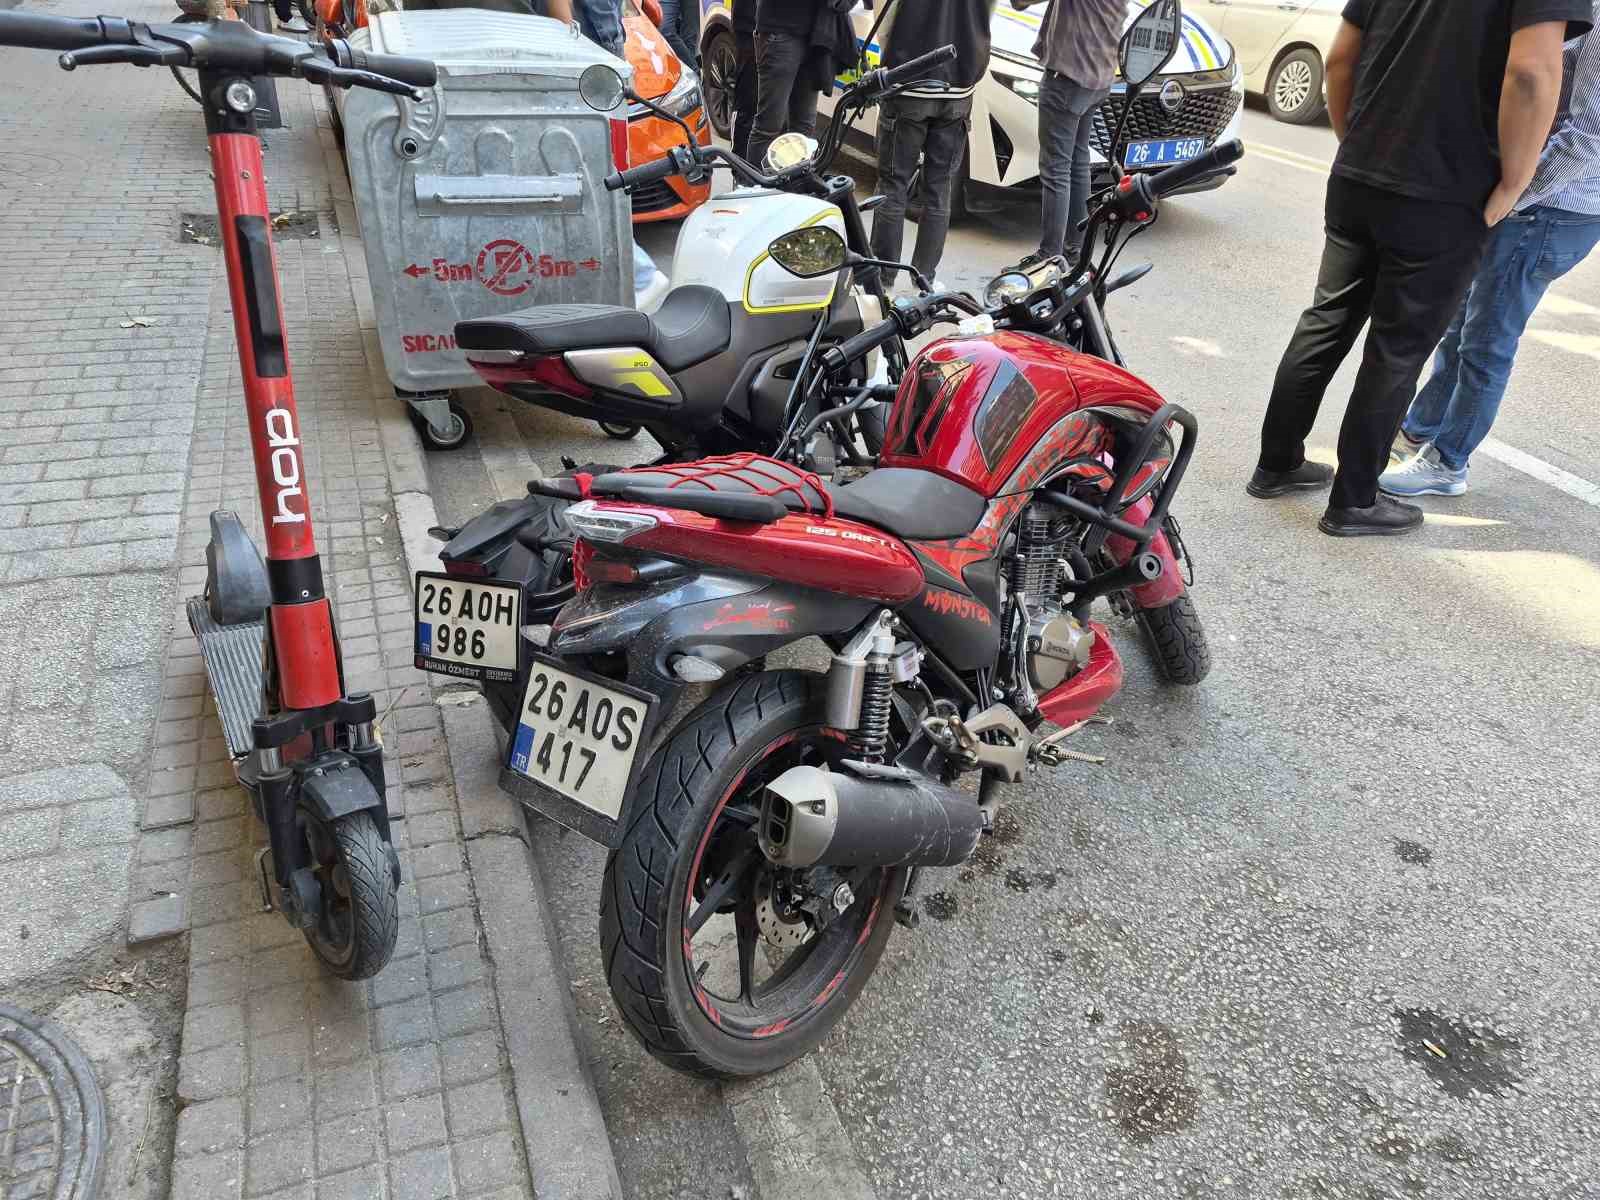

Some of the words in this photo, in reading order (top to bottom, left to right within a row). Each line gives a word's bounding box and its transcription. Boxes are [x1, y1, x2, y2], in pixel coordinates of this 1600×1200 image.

[1133, 144, 1149, 162] 26
[1175, 140, 1203, 159] 5467
[432, 258, 473, 281] 5m
[539, 255, 577, 277] 5m
[266, 408, 305, 524] hop
[805, 525, 837, 537] 125
[436, 623, 485, 659] 986
[514, 752, 528, 769] TR
[536, 732, 597, 792] 417
